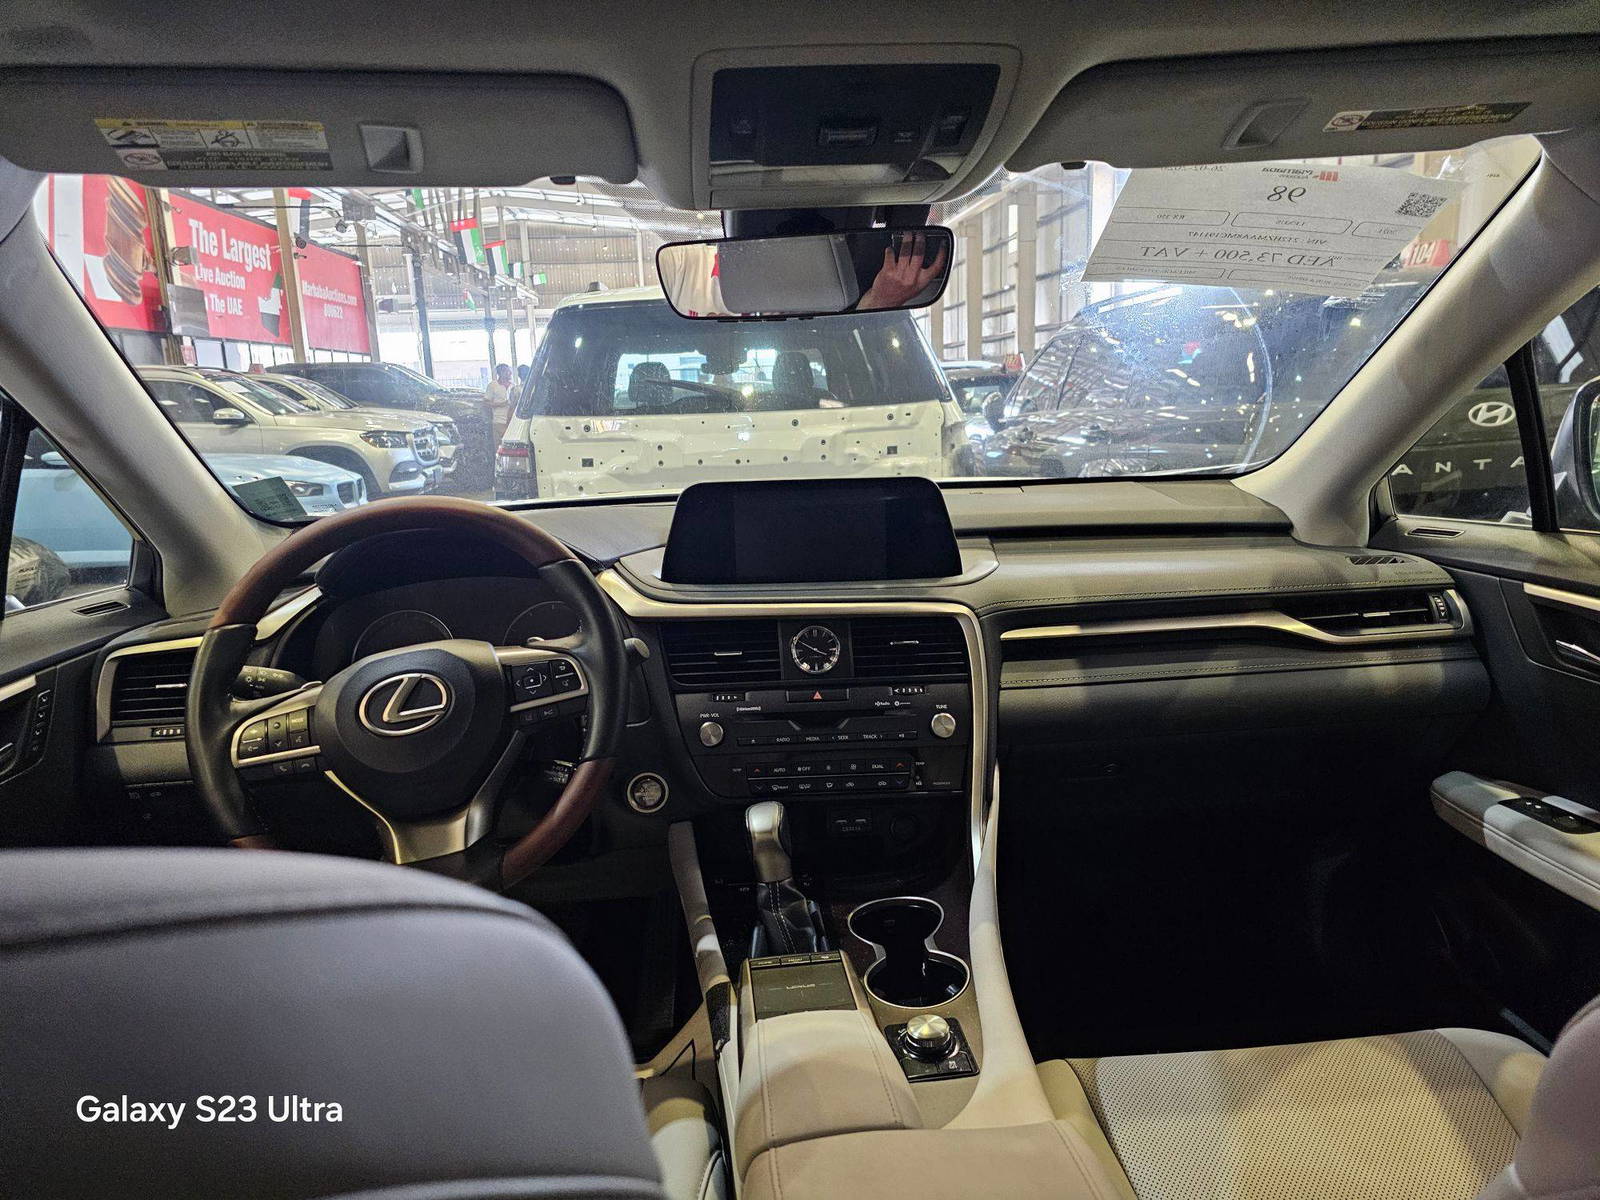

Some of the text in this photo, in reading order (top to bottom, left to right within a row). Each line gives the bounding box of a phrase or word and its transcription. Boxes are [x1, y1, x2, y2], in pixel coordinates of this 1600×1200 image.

[188, 219, 272, 273] The Largest
[215, 266, 246, 291] Auction
[209, 293, 226, 313] The
[226, 296, 244, 316] UAE
